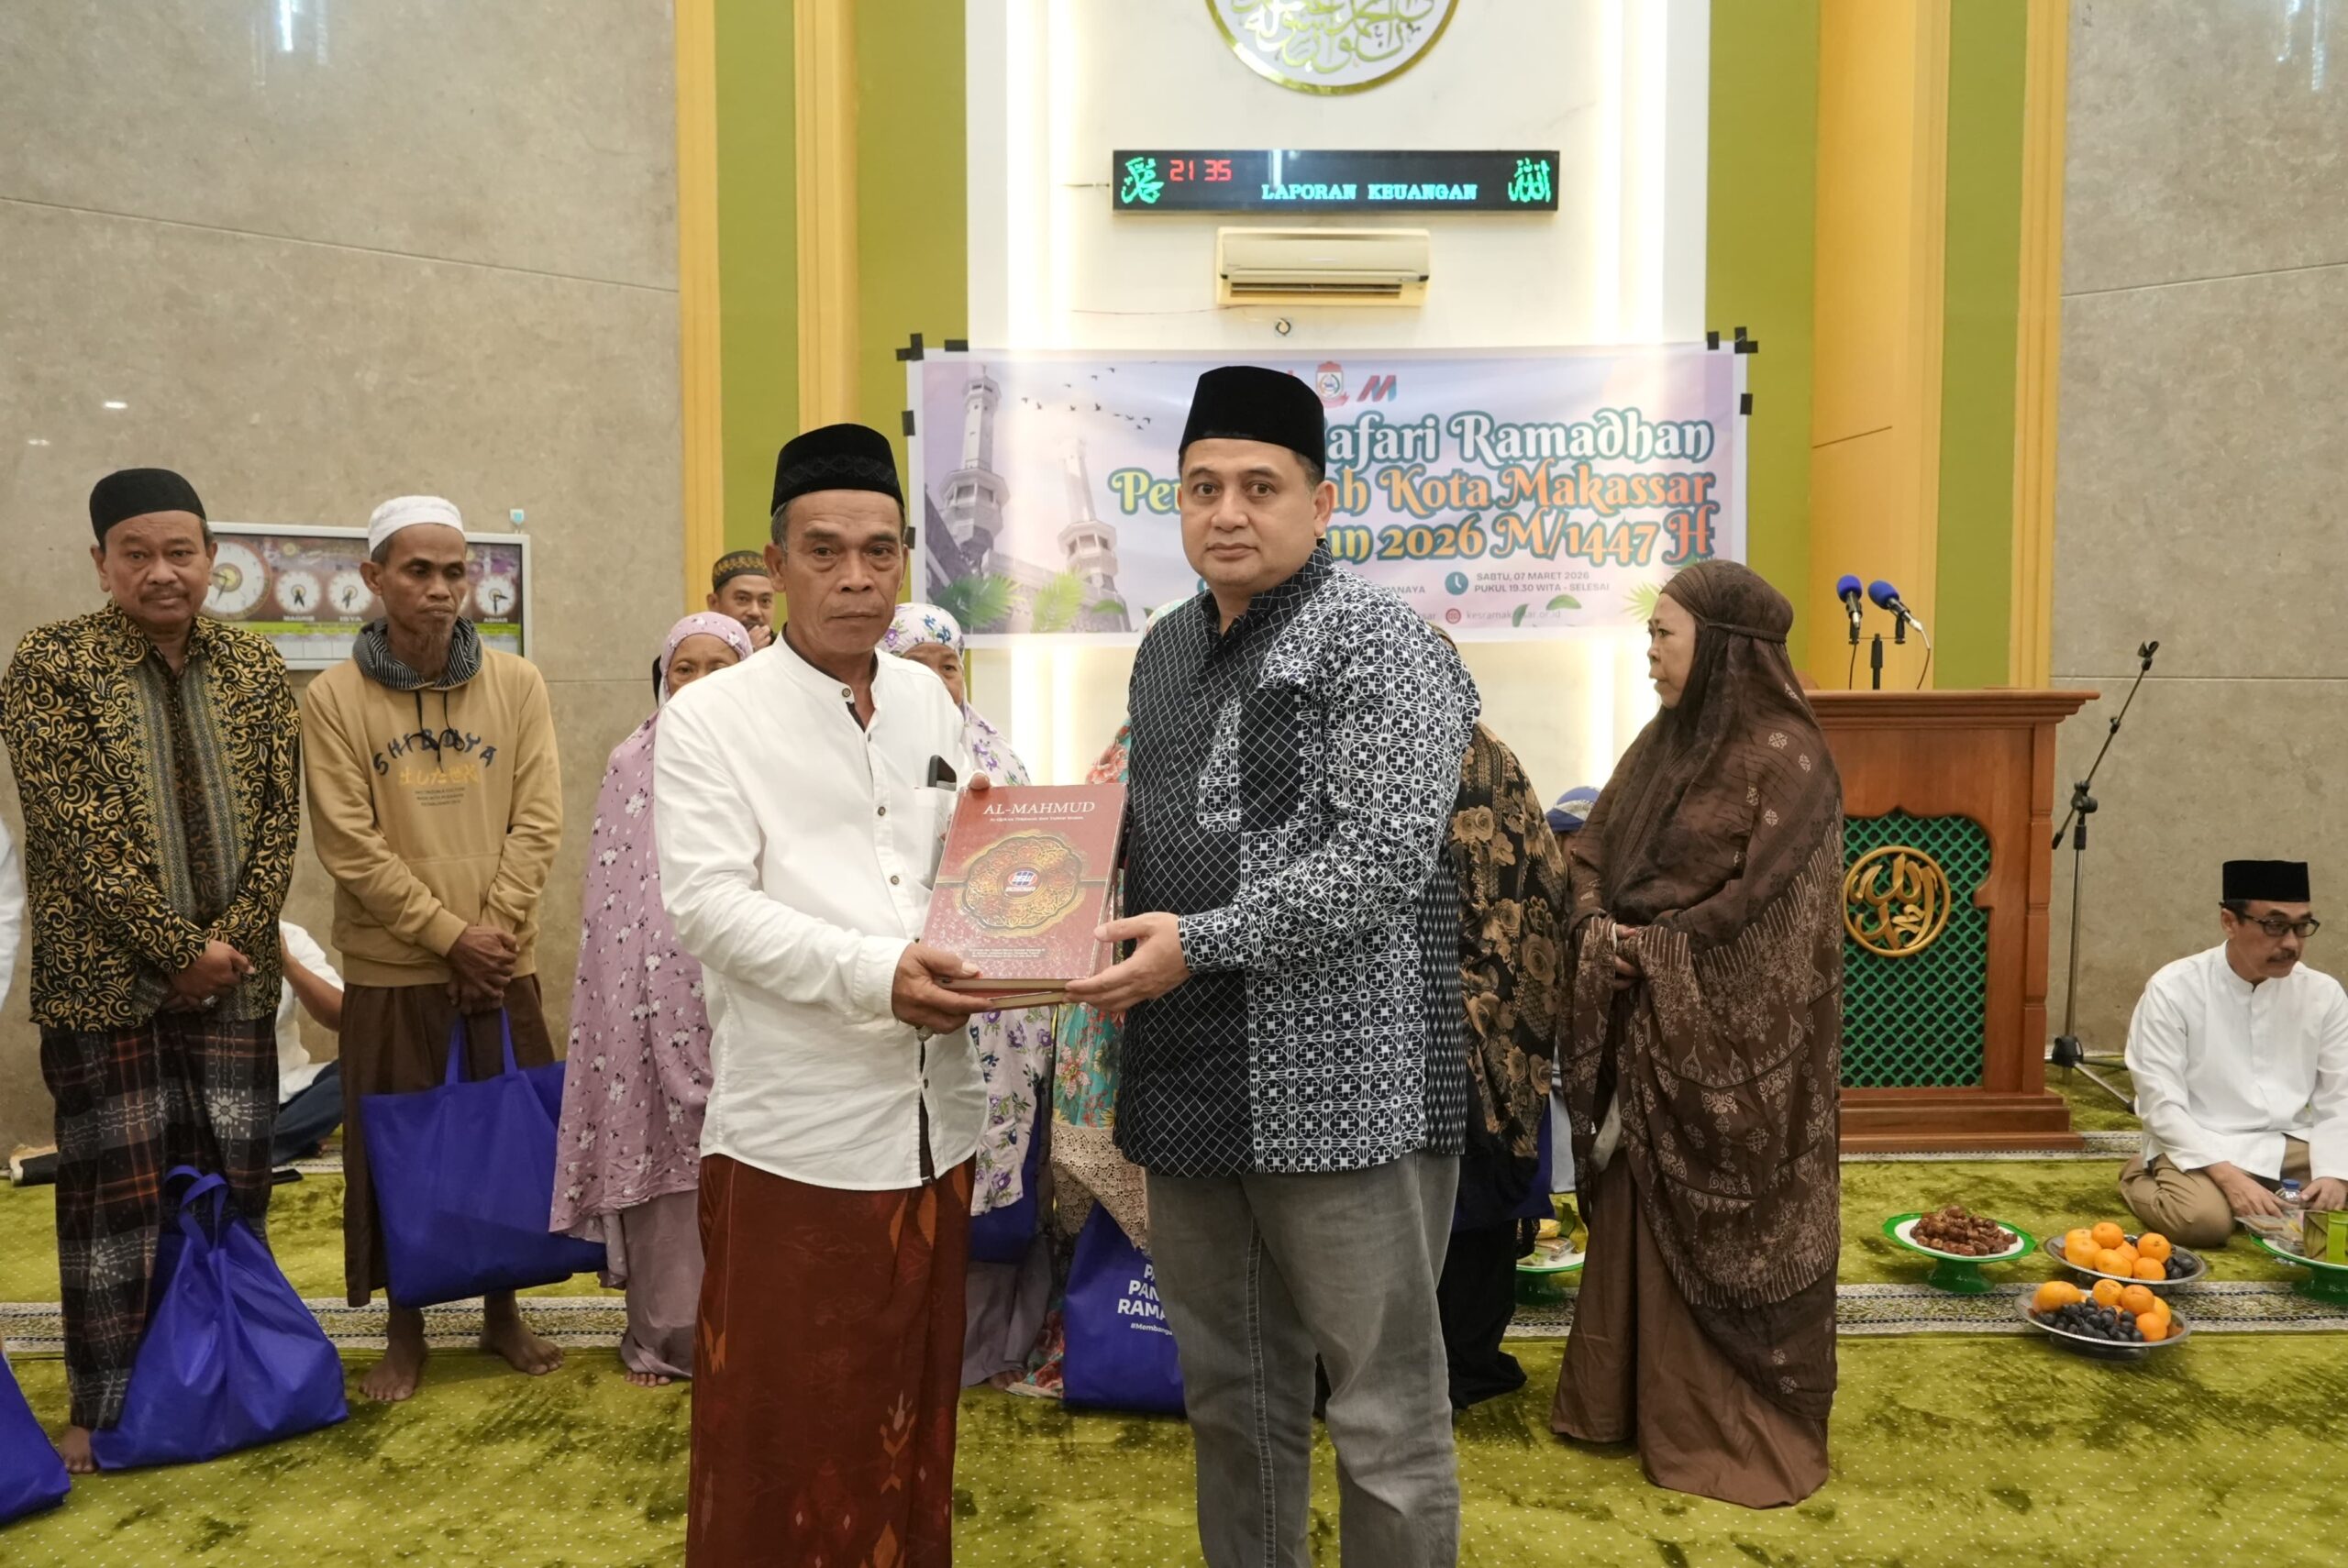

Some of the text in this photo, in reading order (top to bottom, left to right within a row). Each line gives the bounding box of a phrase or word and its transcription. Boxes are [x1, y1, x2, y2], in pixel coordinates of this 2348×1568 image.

[1169, 160, 1233, 182] 21 35
[1261, 184, 1478, 200] LAPORAN KEUANGAN
[1324, 406, 1714, 474] afari Ramadhan
[1376, 464, 1492, 519] Kota
[1498, 456, 1716, 517] Makassar
[1378, 512, 1487, 560] 2026
[1490, 504, 1660, 567] M/1447
[1662, 501, 1720, 565] H
[1477, 571, 1589, 581] SABTU, 07 MARET 2026
[1475, 584, 1507, 592] PUKUL
[1509, 583, 1534, 592] 19.30
[1536, 583, 1561, 592] WITA
[1569, 582, 1610, 591] SELESAI
[983, 801, 1095, 815] AL-MAHMUD
